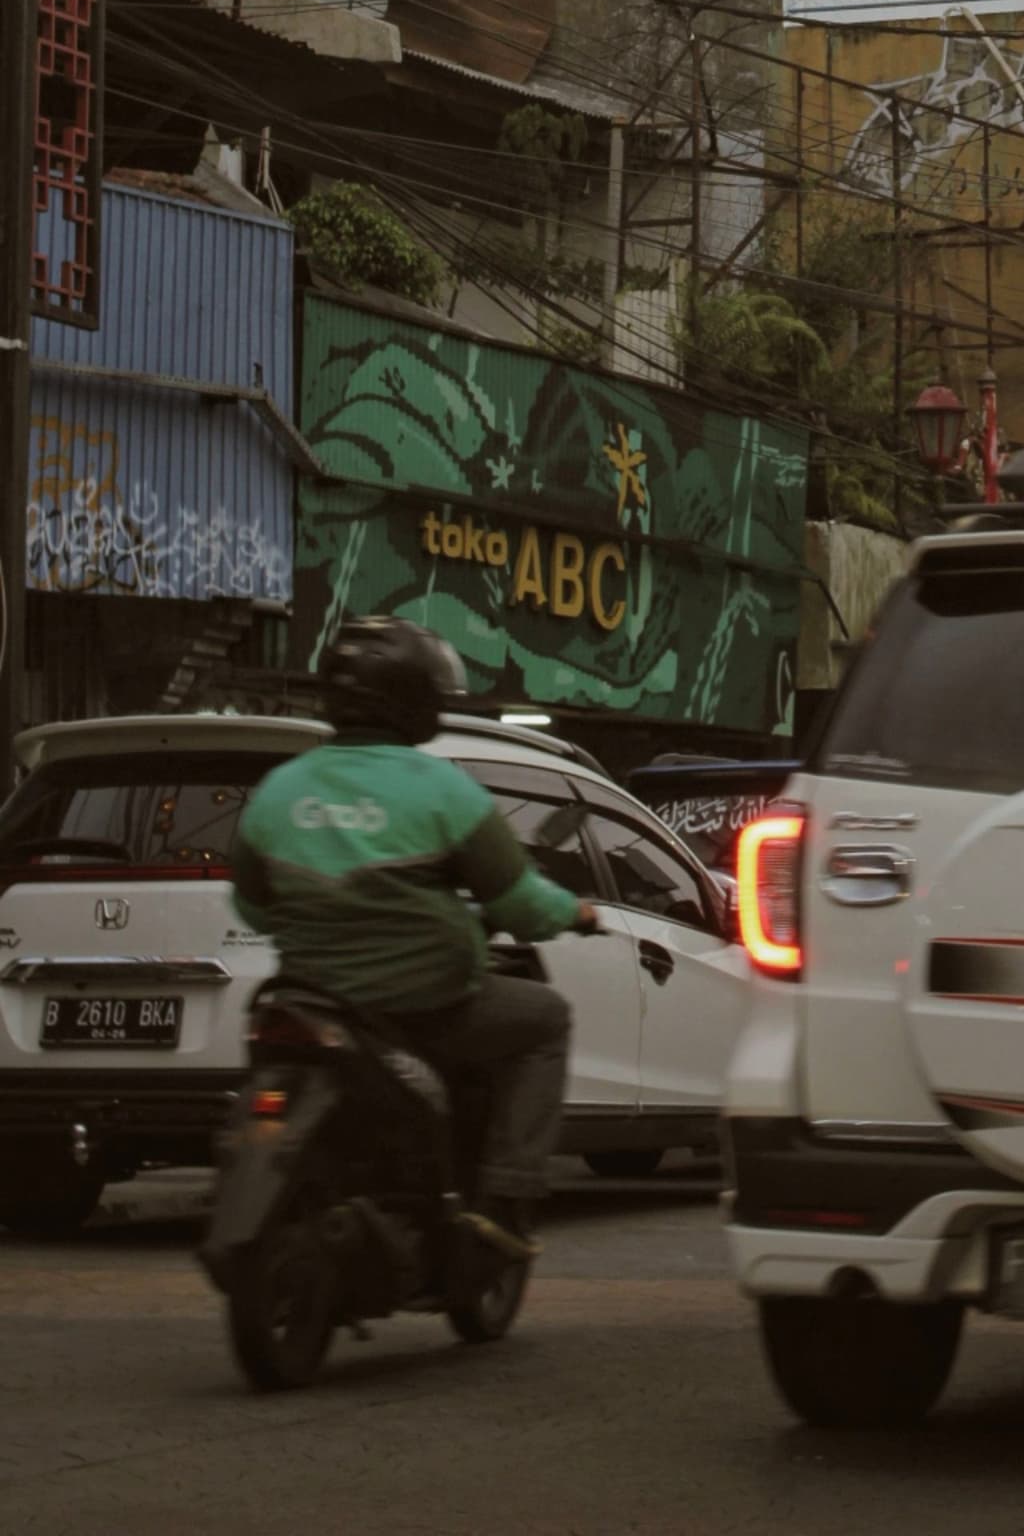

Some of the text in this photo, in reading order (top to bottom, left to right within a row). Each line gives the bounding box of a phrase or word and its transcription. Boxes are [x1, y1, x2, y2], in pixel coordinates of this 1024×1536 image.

[423, 510, 626, 631] toko ABC
[46, 1000, 176, 1026] B 2610 BKA
